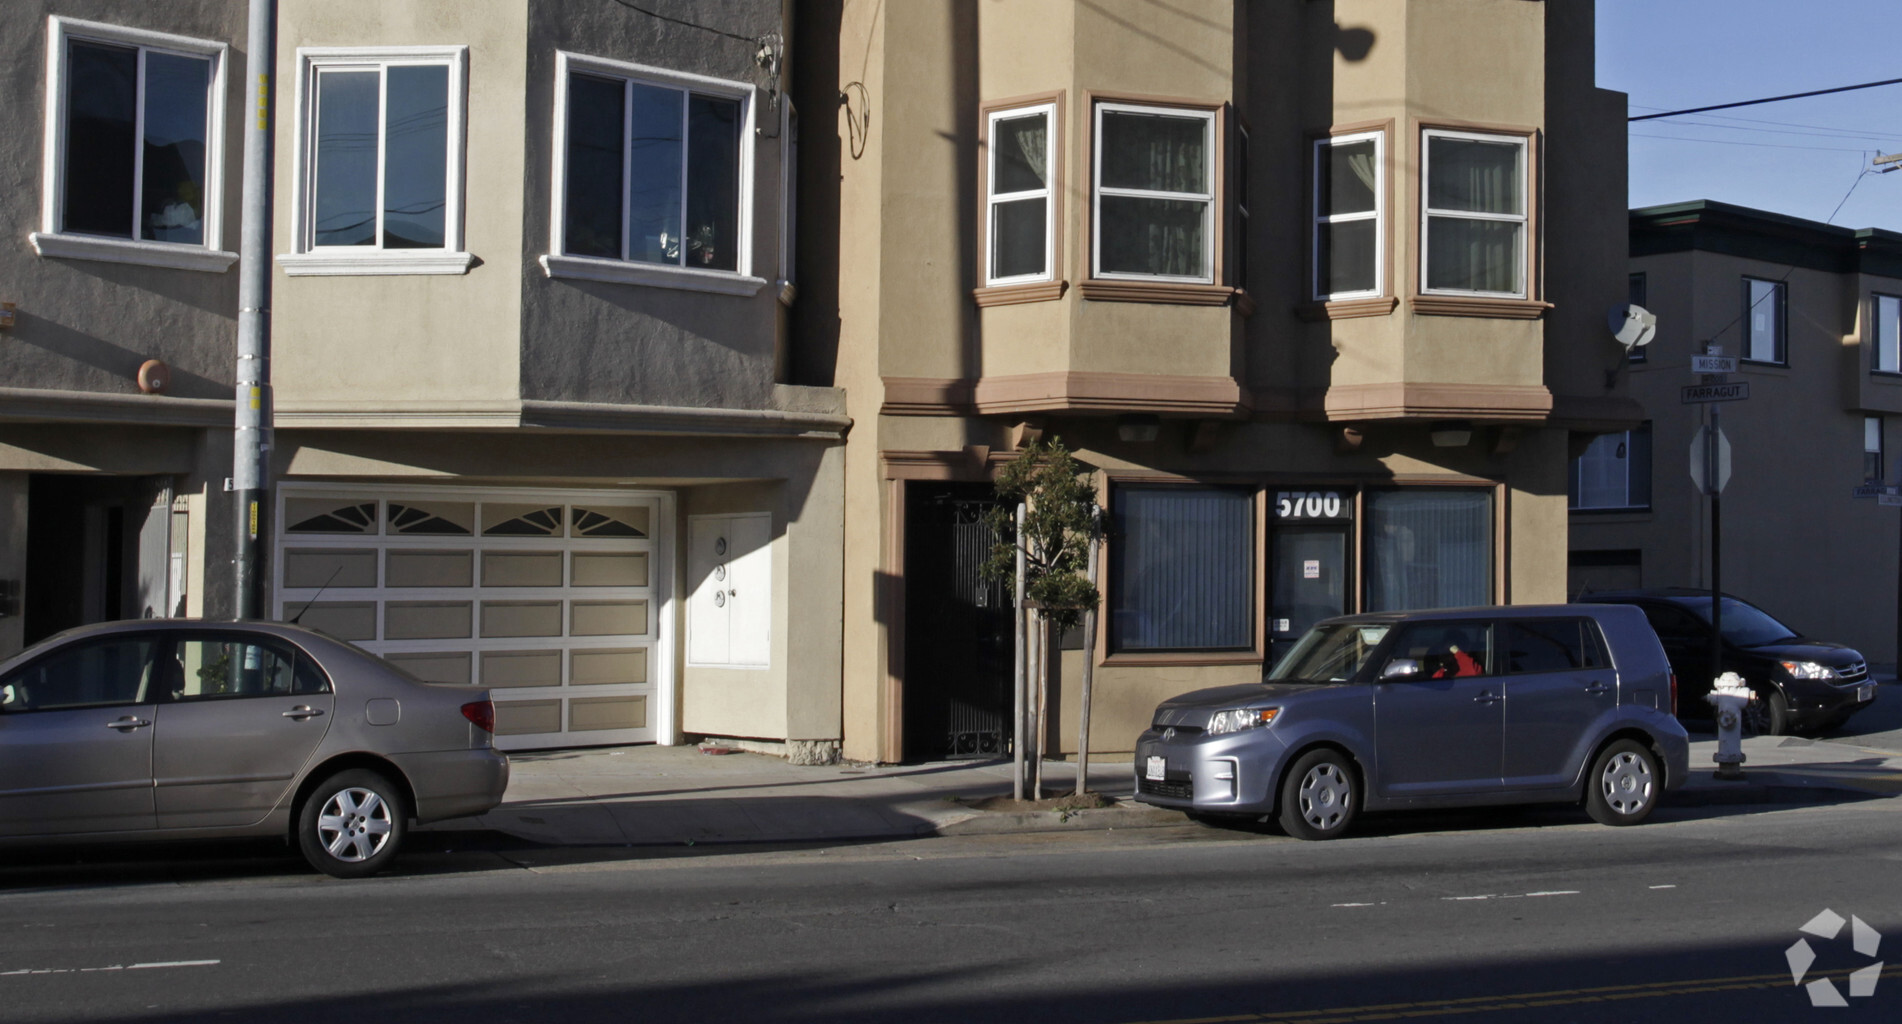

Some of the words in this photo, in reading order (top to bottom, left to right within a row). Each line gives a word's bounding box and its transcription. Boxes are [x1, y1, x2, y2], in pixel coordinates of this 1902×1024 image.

[1698, 359, 1732, 370] MISSION
[1686, 386, 1741, 400] FARRAGUT
[1275, 491, 1341, 518] 5700
